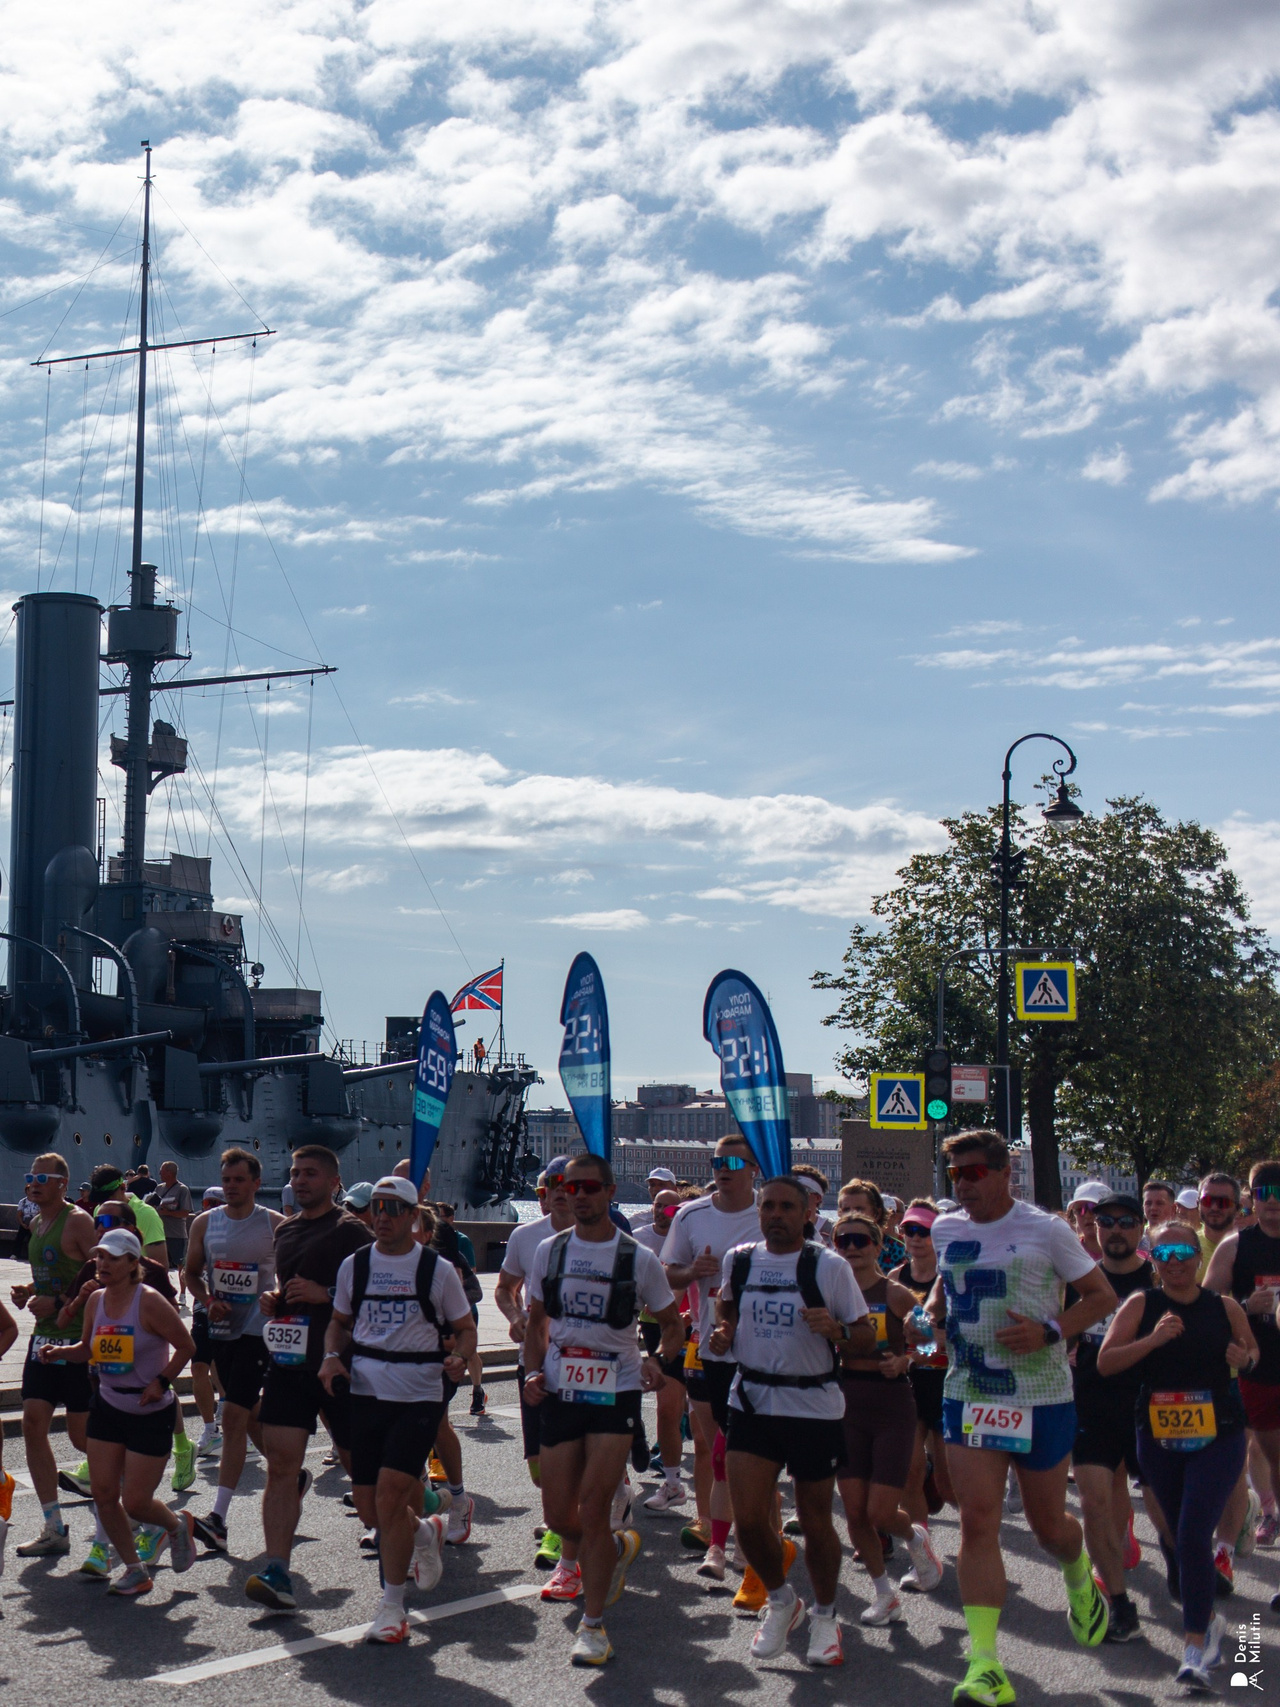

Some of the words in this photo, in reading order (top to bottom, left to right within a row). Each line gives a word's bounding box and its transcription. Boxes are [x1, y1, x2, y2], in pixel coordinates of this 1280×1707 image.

[418, 1045, 447, 1093] 1:59
[863, 1161, 905, 1169] АВРОРА
[220, 1272, 252, 1287] 4046
[570, 1268, 611, 1278] МАРАФОН
[761, 1270, 783, 1278] ПОЛУ
[760, 1277, 797, 1286] МАРАФО
[368, 1300, 406, 1323] 1:59
[564, 1292, 603, 1317] 1:59
[753, 1300, 795, 1327] 1:59
[268, 1327, 302, 1345] 5352
[100, 1339, 122, 1354] 864
[566, 1365, 608, 1385] 7617
[565, 1391, 572, 1401] E
[972, 1408, 1023, 1430] 7459
[1157, 1408, 1205, 1428] 5321
[972, 1435, 979, 1446] E
